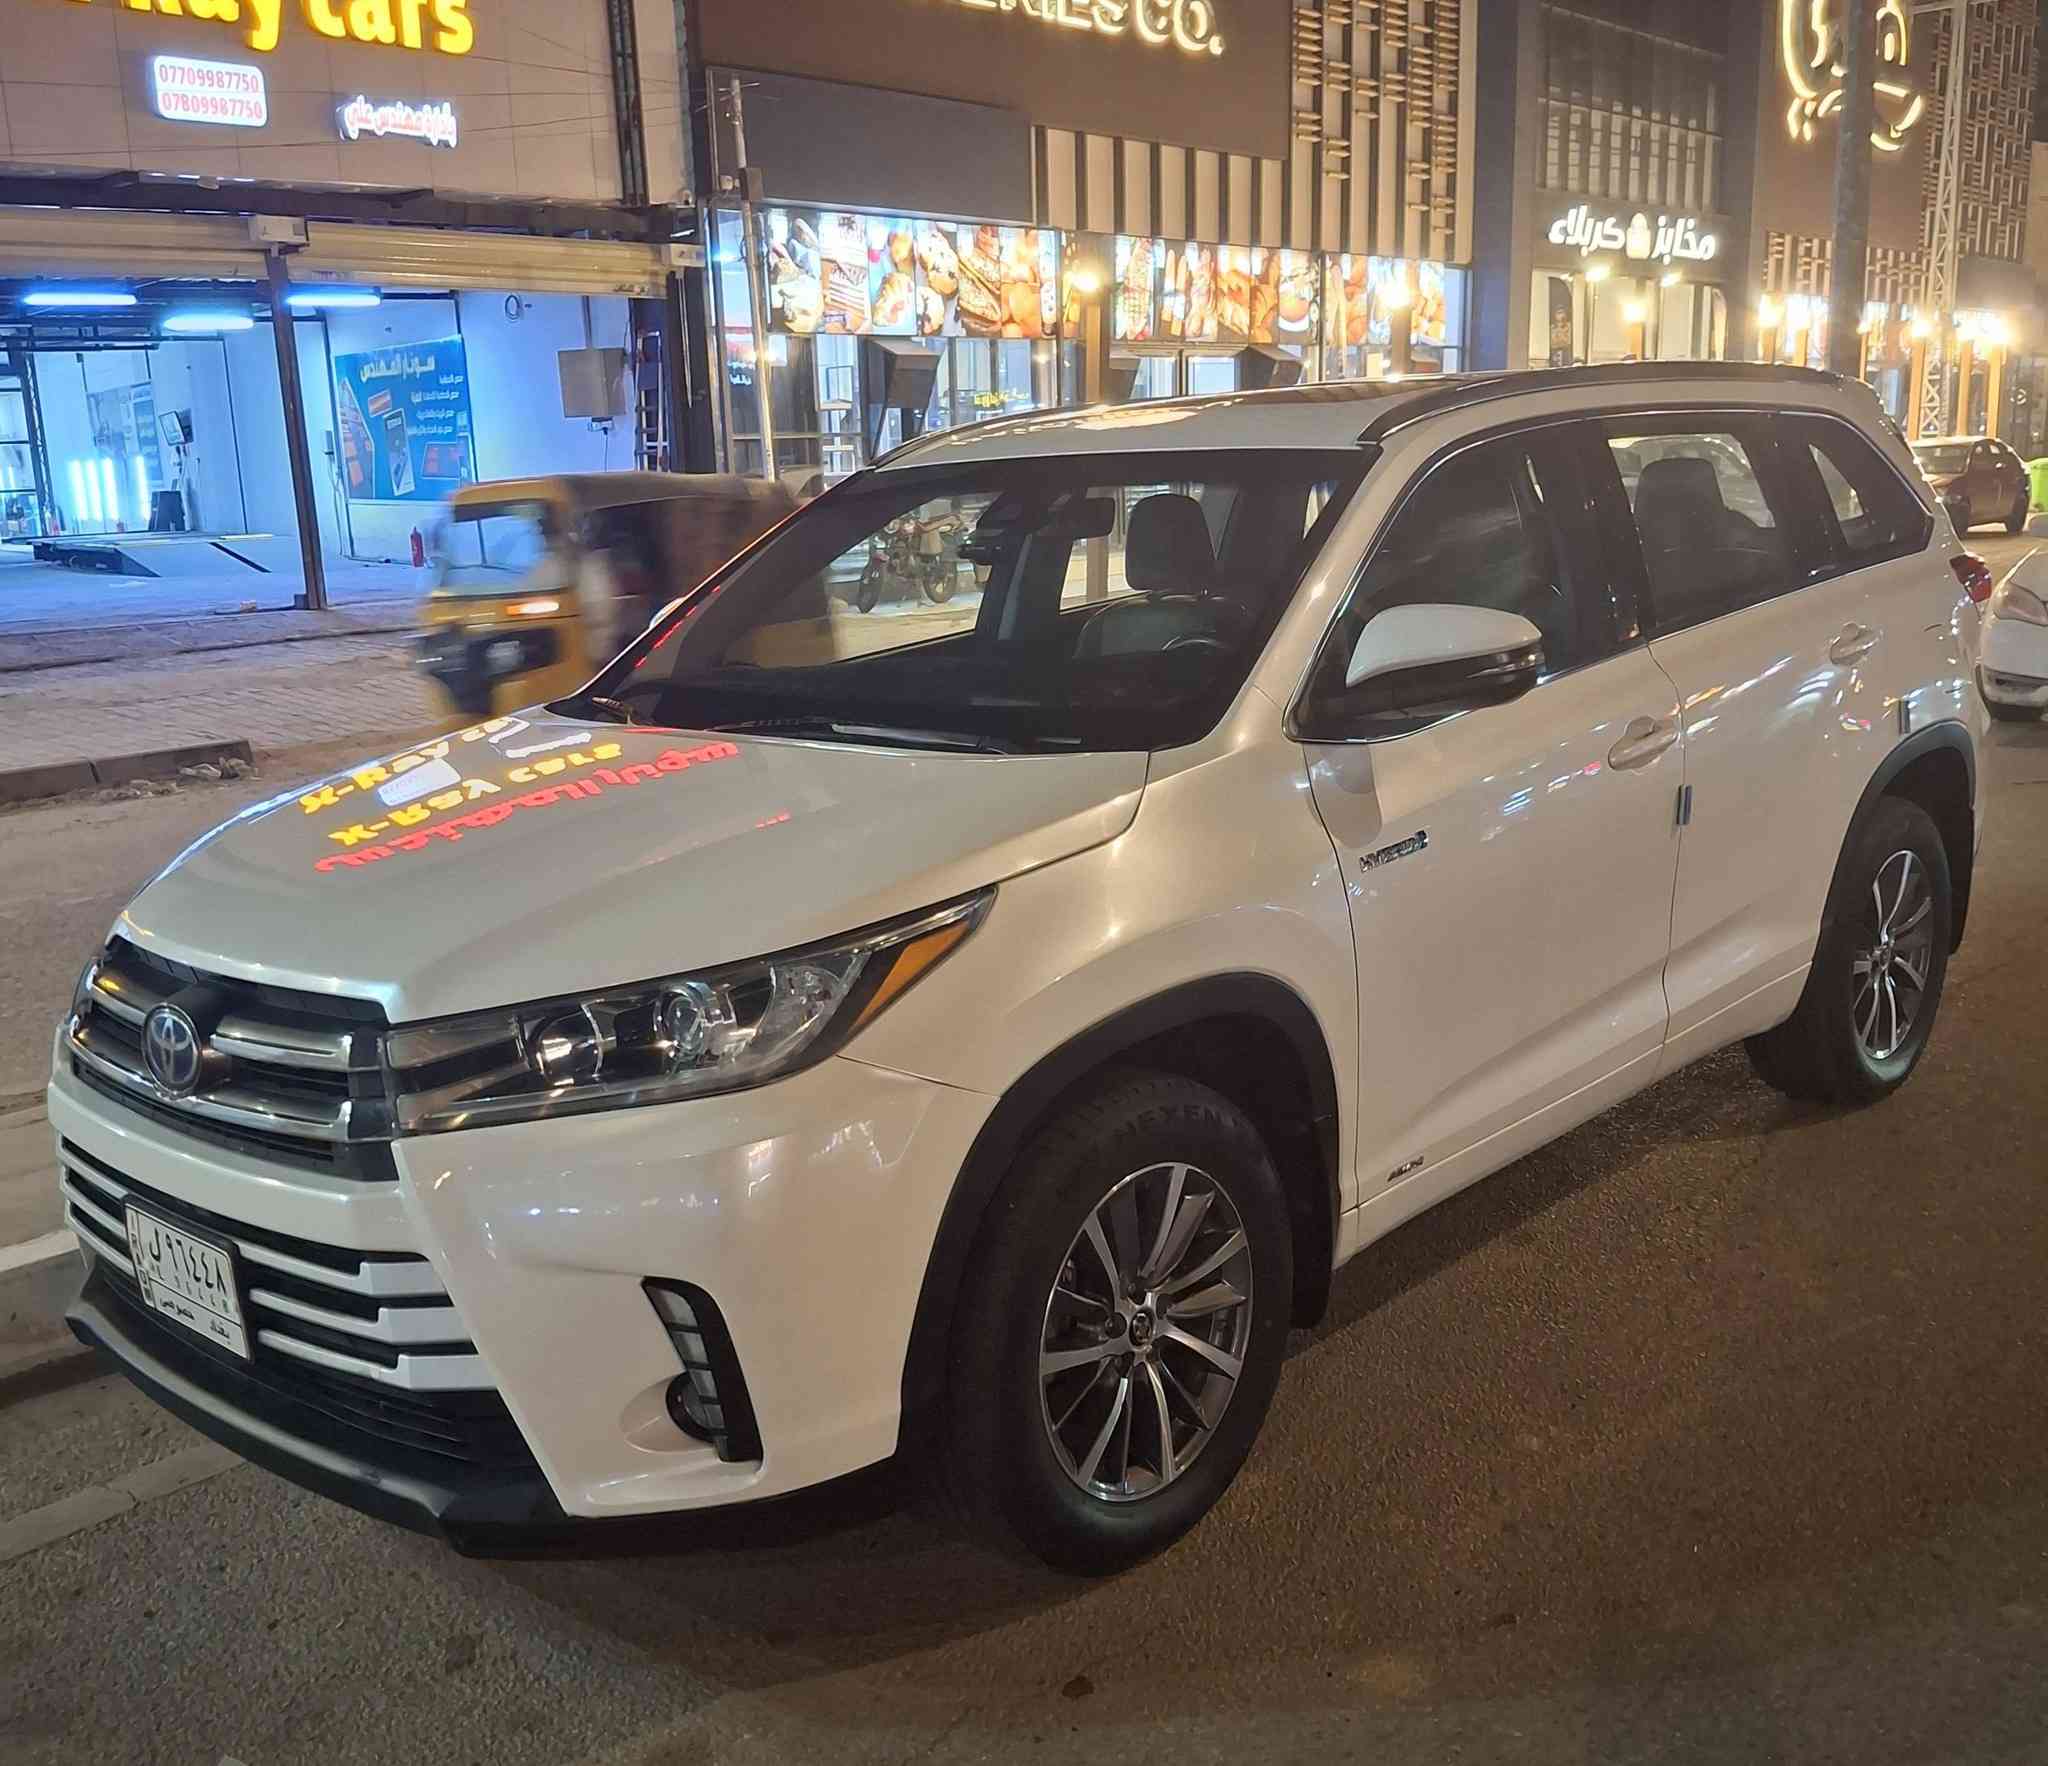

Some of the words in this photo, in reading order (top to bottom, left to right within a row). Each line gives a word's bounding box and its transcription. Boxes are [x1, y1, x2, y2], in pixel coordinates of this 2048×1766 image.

[159, 64, 260, 93] 07709987750
[161, 92, 264, 120] 07809987750
[1548, 204, 1626, 257] كربلاء
[1651, 215, 1716, 265] مخابز
